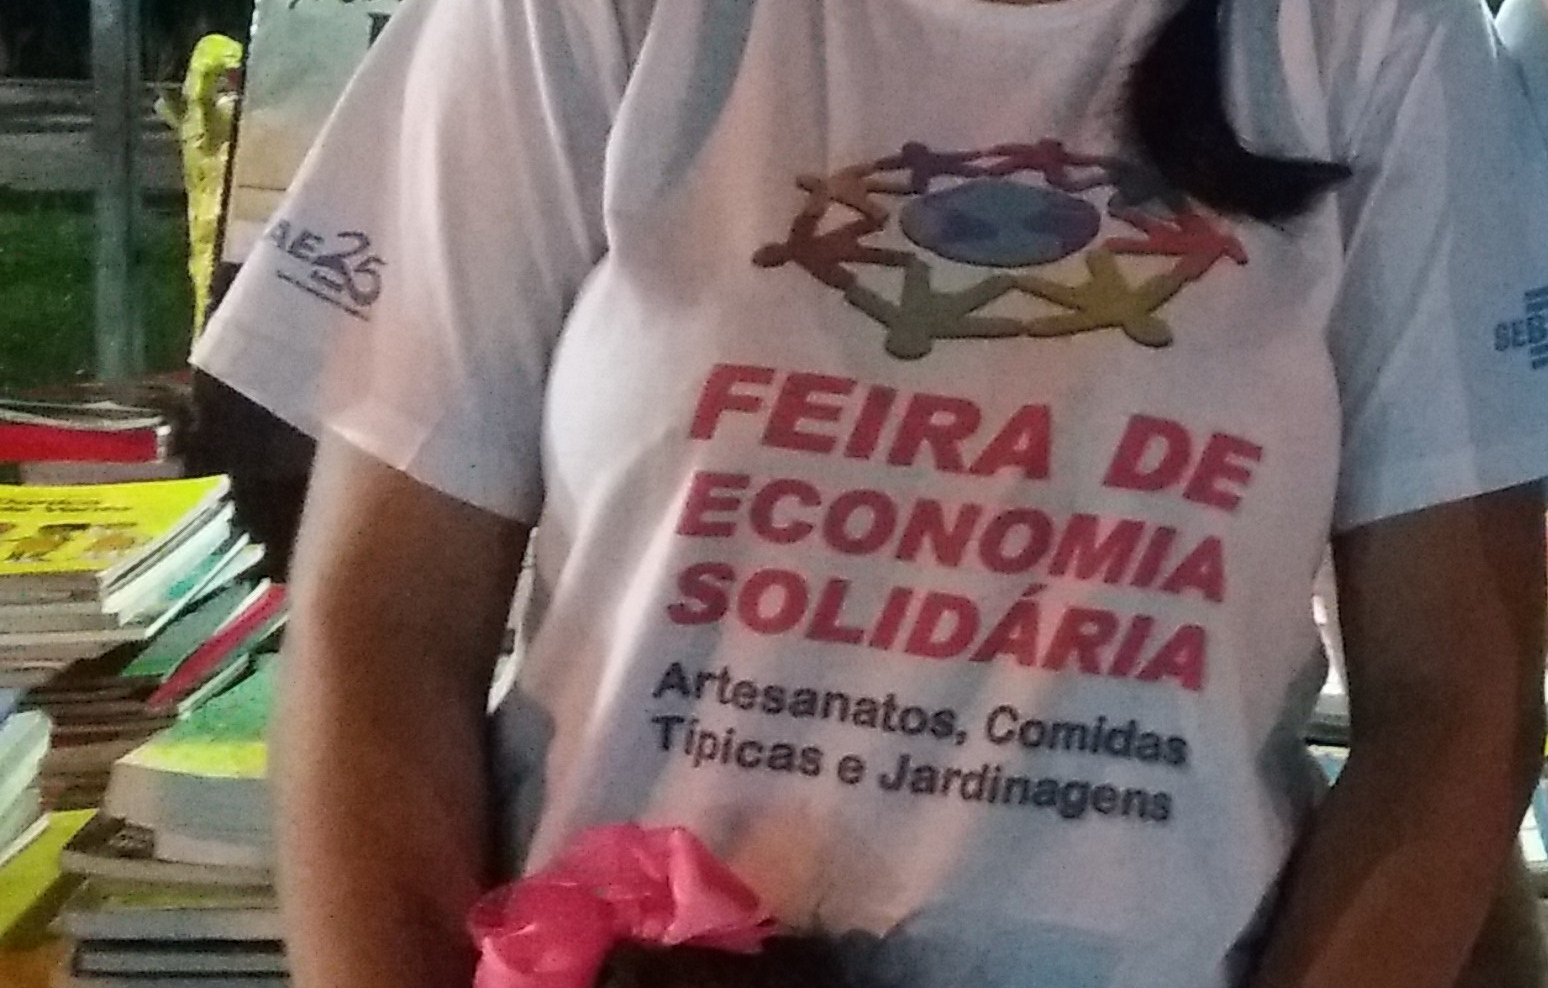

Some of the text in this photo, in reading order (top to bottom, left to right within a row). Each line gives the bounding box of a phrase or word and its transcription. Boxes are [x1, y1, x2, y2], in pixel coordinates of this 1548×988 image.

[690, 363, 1263, 512] FEIRA DE
[676, 469, 1227, 604] ECONOMIA
[666, 561, 1210, 693] SOLIDÁRIA
[651, 714, 1175, 823] Típicas e Jardinagens
[652, 661, 1191, 767] Artesanatos, Comidas
